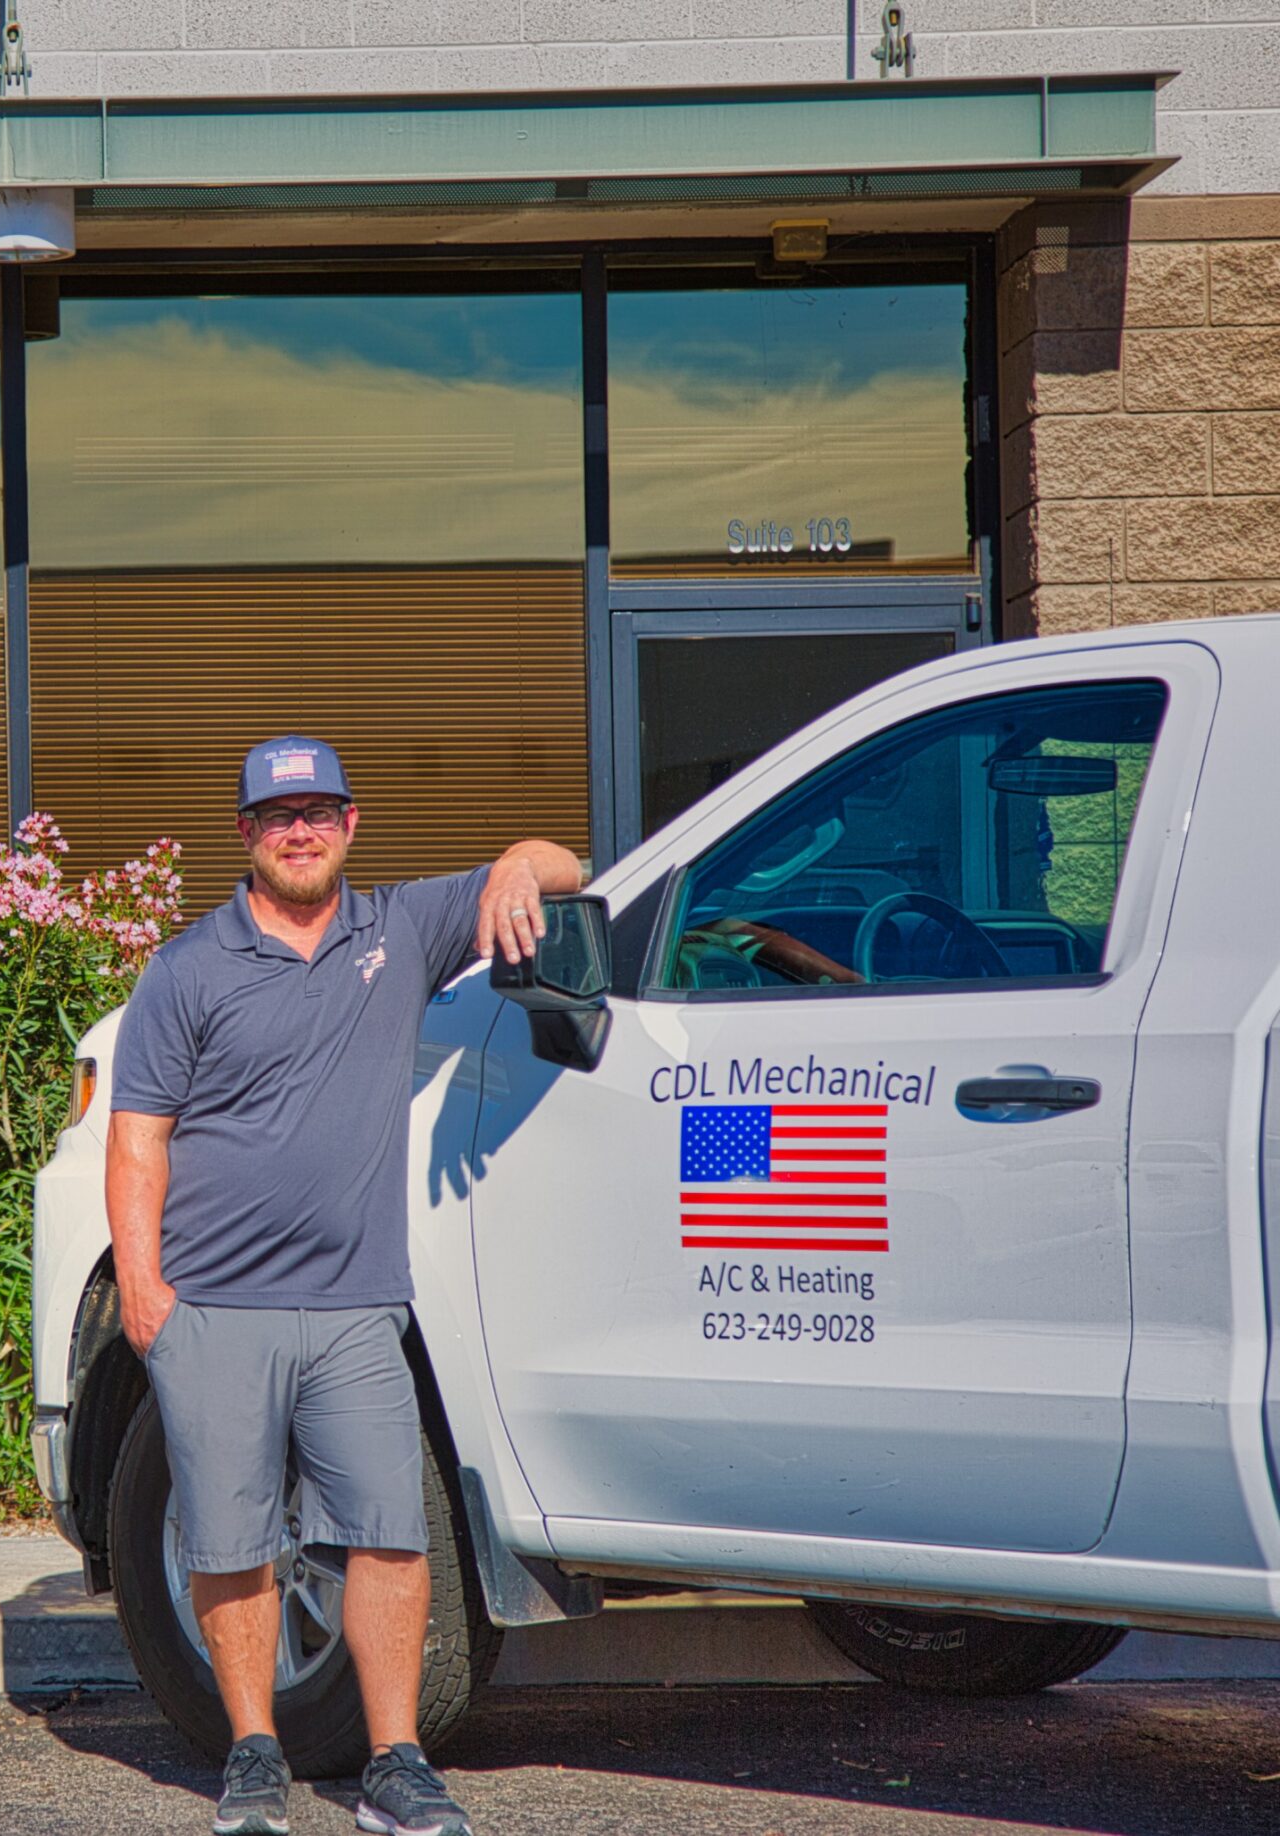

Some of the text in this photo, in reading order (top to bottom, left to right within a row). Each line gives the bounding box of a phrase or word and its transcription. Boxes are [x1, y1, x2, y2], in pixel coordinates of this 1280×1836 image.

[727, 517, 852, 554] Suite 103
[650, 1054, 937, 1106] CDL Mechanical
[699, 1262, 875, 1301] A/C & Heating
[702, 1312, 876, 1343] 623-249-9028
[840, 1601, 966, 1650] DISCOV
